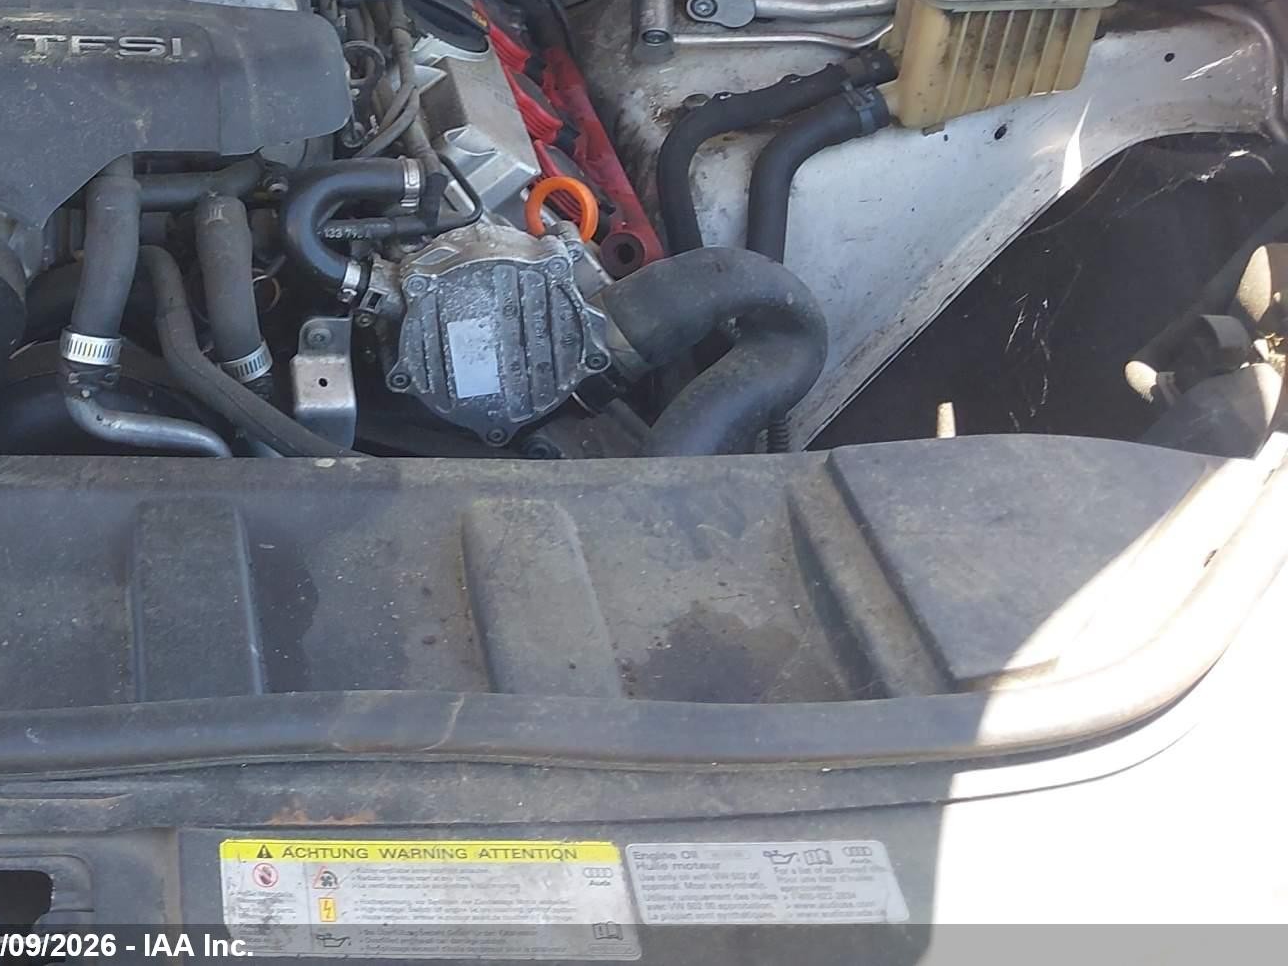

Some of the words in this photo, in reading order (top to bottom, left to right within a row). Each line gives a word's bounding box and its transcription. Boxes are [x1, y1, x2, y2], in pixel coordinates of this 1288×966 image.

[16, 34, 183, 56] TFSI
[281, 847, 369, 859] ACHTUNG
[378, 848, 468, 859] WARNING
[478, 848, 578, 860] ATTENTION
[632, 851, 677, 861] Engine
[680, 850, 698, 859] Oil
[672, 862, 720, 870] moteur
